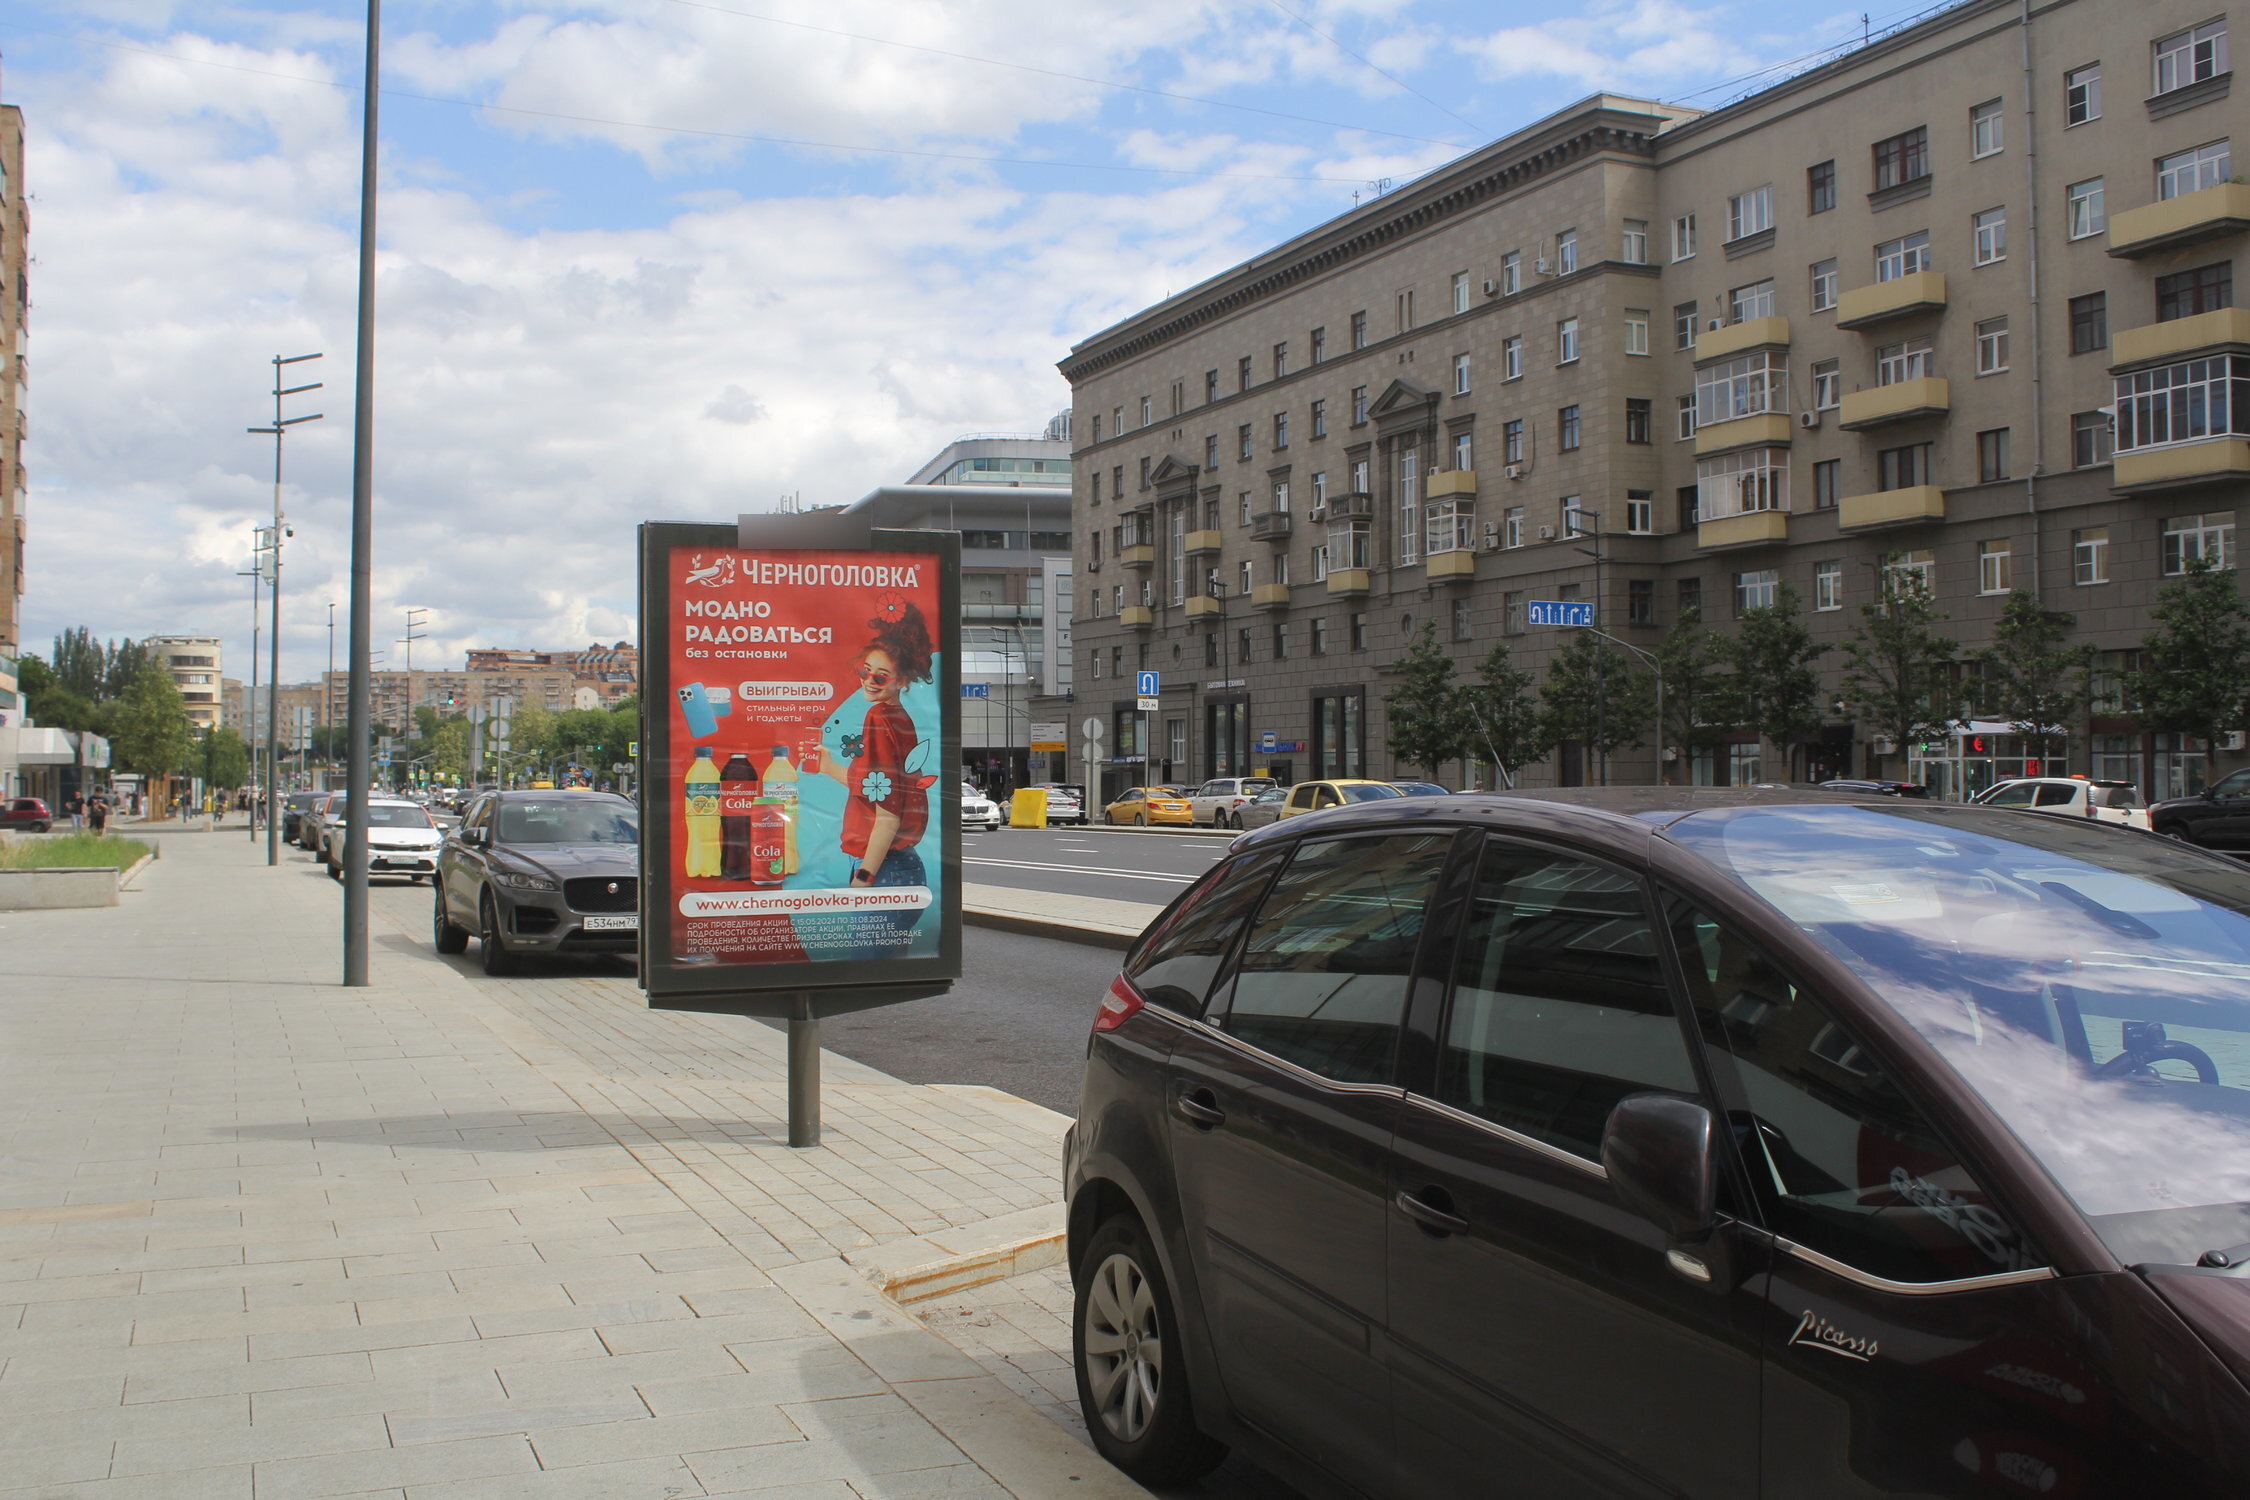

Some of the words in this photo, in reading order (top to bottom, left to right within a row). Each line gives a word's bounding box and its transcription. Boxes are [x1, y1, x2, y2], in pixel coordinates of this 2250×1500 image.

[685, 600, 771, 620] МОДНО
[685, 625, 832, 644] РАДОВАТЬСЯ
[685, 647, 709, 659] без
[714, 650, 788, 659] остановки
[746, 684, 826, 696] ВЫИГРЫВАЙ
[746, 704, 796, 712] стильный
[798, 705, 826, 713] мерч
[1141, 700, 1150, 708] 30
[756, 715, 802, 723] гаджеты
[725, 798, 752, 809] Cola
[753, 845, 781, 857] Cola
[696, 893, 919, 911] www.chernogolovka-promo.ru
[687, 922, 709, 930] СРОК
[710, 920, 761, 929] ПРОВЕДЕНИЯ
[763, 919, 788, 927] АКЦИИ
[687, 928, 745, 938] ПОДРОБНОСТИ
[760, 925, 817, 935] ОРГАНИЗАТОРЕ
[847, 923, 885, 932] ПРАВИЛАХ
[742, 935, 790, 944] КОЛИЧЕСТВЕ
[856, 931, 880, 939] МЕСТЕ
[888, 929, 922, 938] ПОРЯДКЕ
[700, 944, 745, 953] ПОЛУЧЕНИЯ
[758, 943, 782, 951] САЙТЕ
[1788, 1309, 1878, 1356] Picasso
